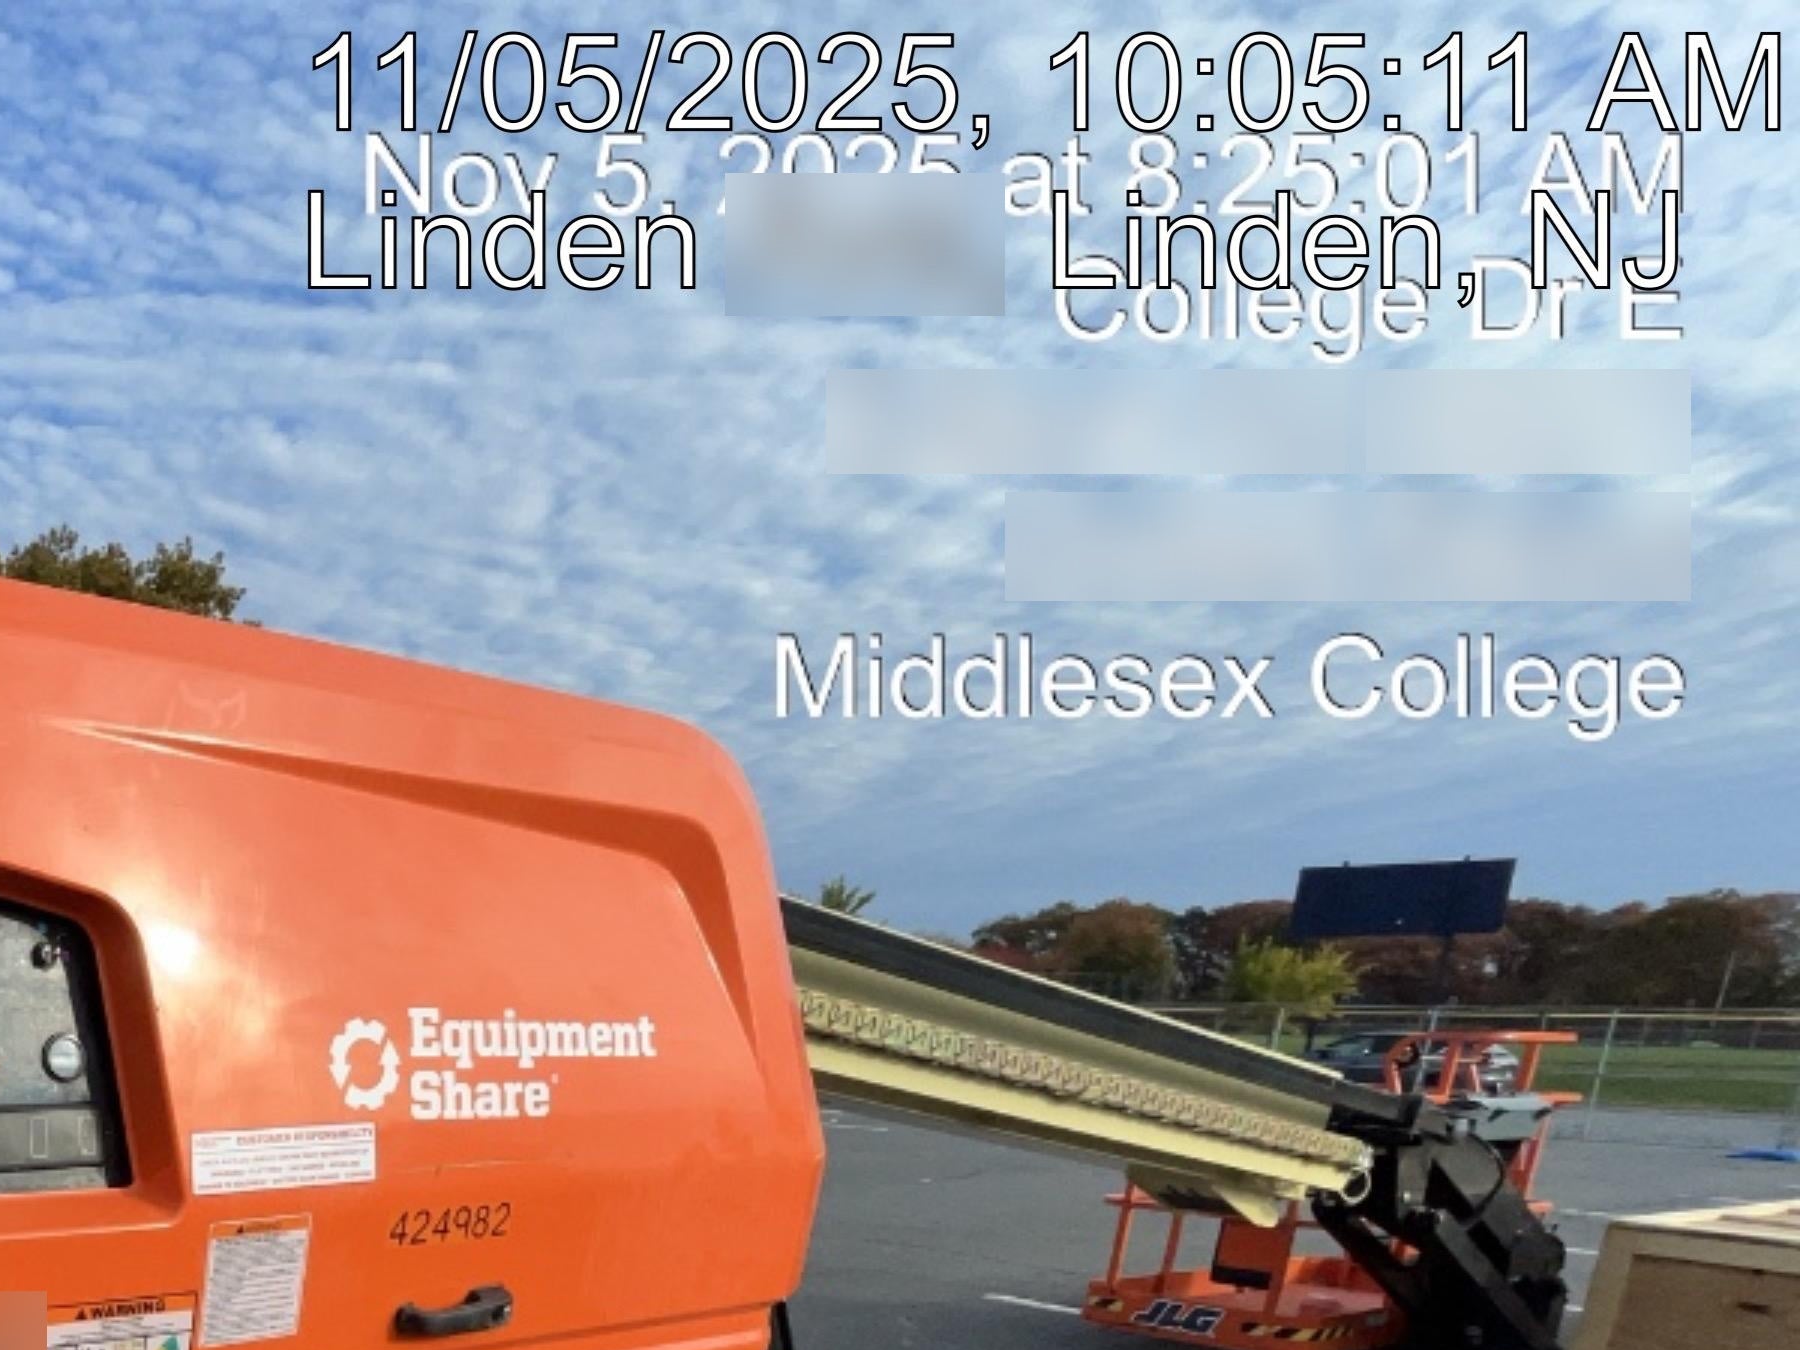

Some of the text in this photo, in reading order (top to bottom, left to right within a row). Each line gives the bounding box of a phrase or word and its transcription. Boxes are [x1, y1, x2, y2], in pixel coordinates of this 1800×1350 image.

[407, 1006, 658, 1069] Equipment
[409, 1070, 550, 1121] Share
[389, 1202, 512, 1246] 424982
[90, 1299, 166, 1319] WARNING
[1128, 1298, 1226, 1337] JLG
